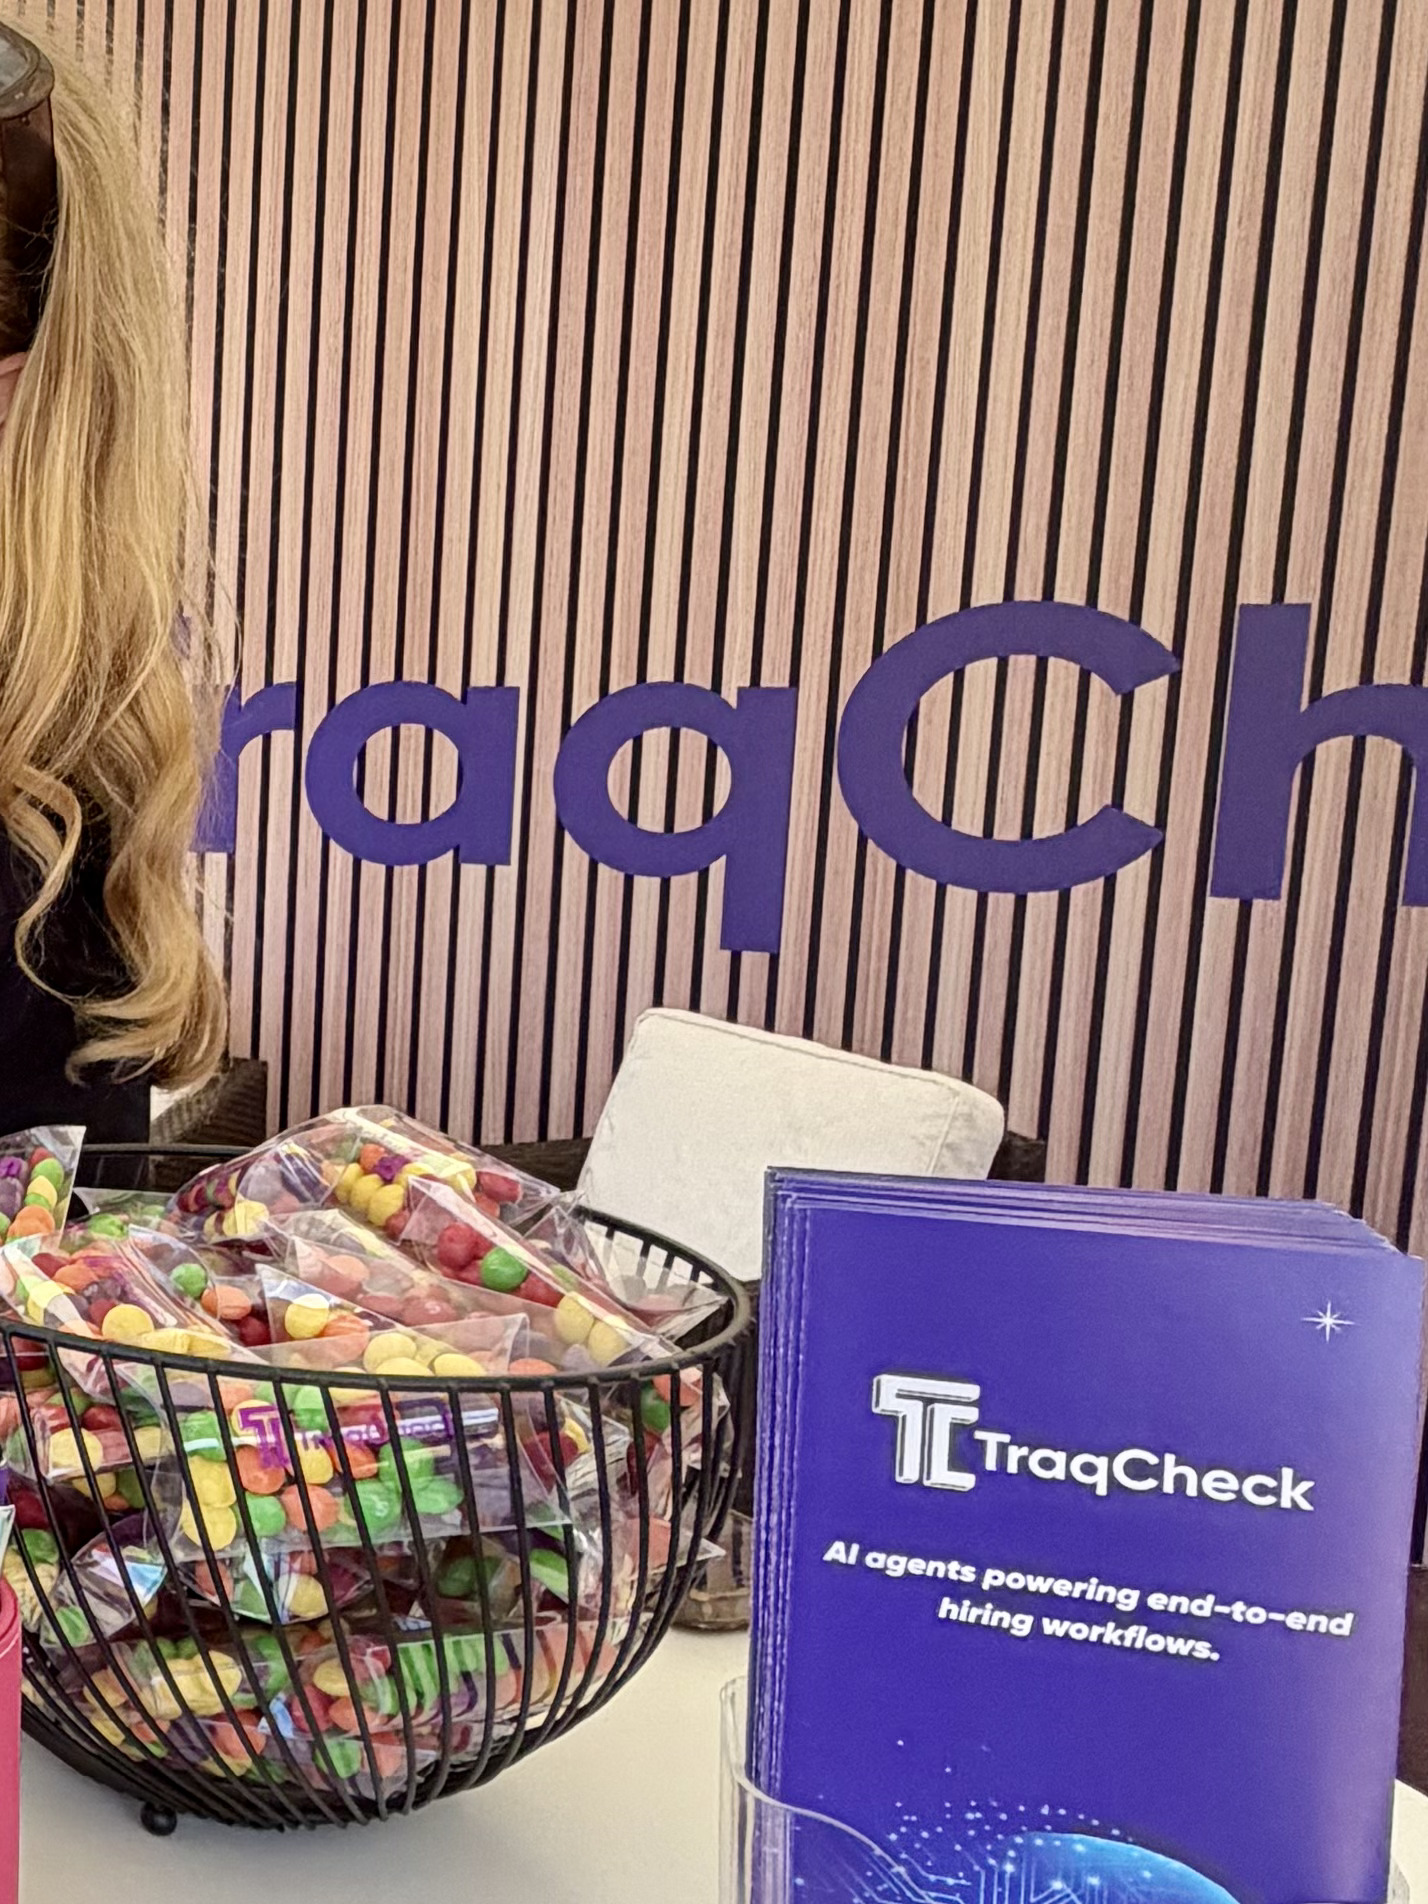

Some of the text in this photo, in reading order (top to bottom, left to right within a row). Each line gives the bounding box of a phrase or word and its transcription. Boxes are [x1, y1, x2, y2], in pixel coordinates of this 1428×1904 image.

[180, 599, 1428, 953] raqCh
[973, 1429, 1315, 1512] TraqCheck
[823, 1541, 1354, 1637] AI agents powering end-to-end
[938, 1597, 1221, 1660] hiring workflows.
